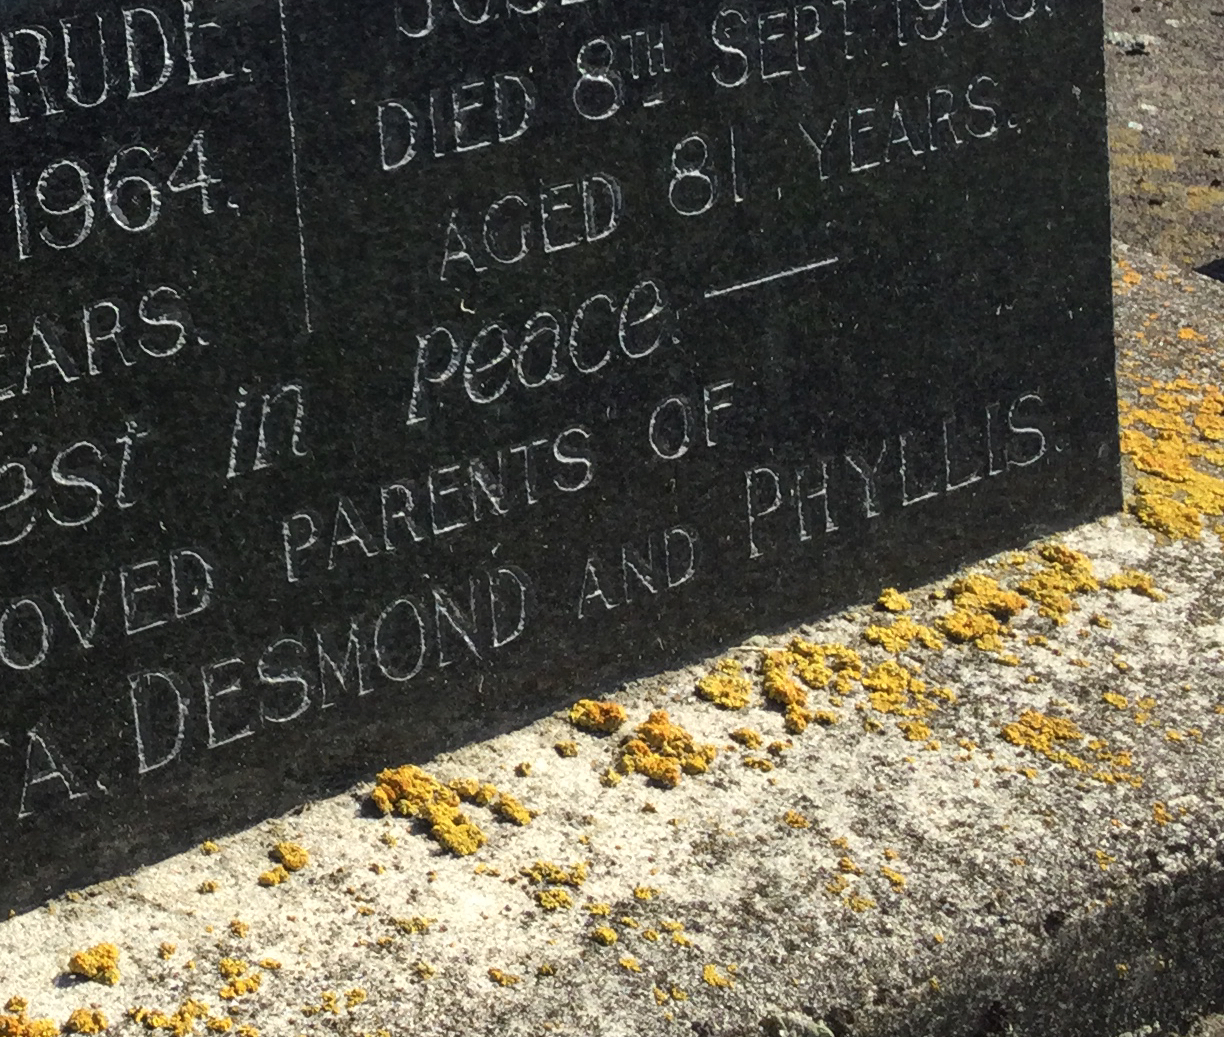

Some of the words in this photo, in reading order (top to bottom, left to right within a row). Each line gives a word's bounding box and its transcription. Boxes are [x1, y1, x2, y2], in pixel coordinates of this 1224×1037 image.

[376, 72, 532, 172] DIED
[572, 20, 674, 122] 8TH
[11, 128, 242, 261] 1964.
[438, 174, 624, 282] AGED
[668, 124, 746, 218] 81
[224, 384, 308, 480] in
[280, 426, 596, 583] PARENTS
[646, 379, 736, 460] OF
[126, 566, 530, 776] DESMOND
[576, 528, 698, 620] AND
